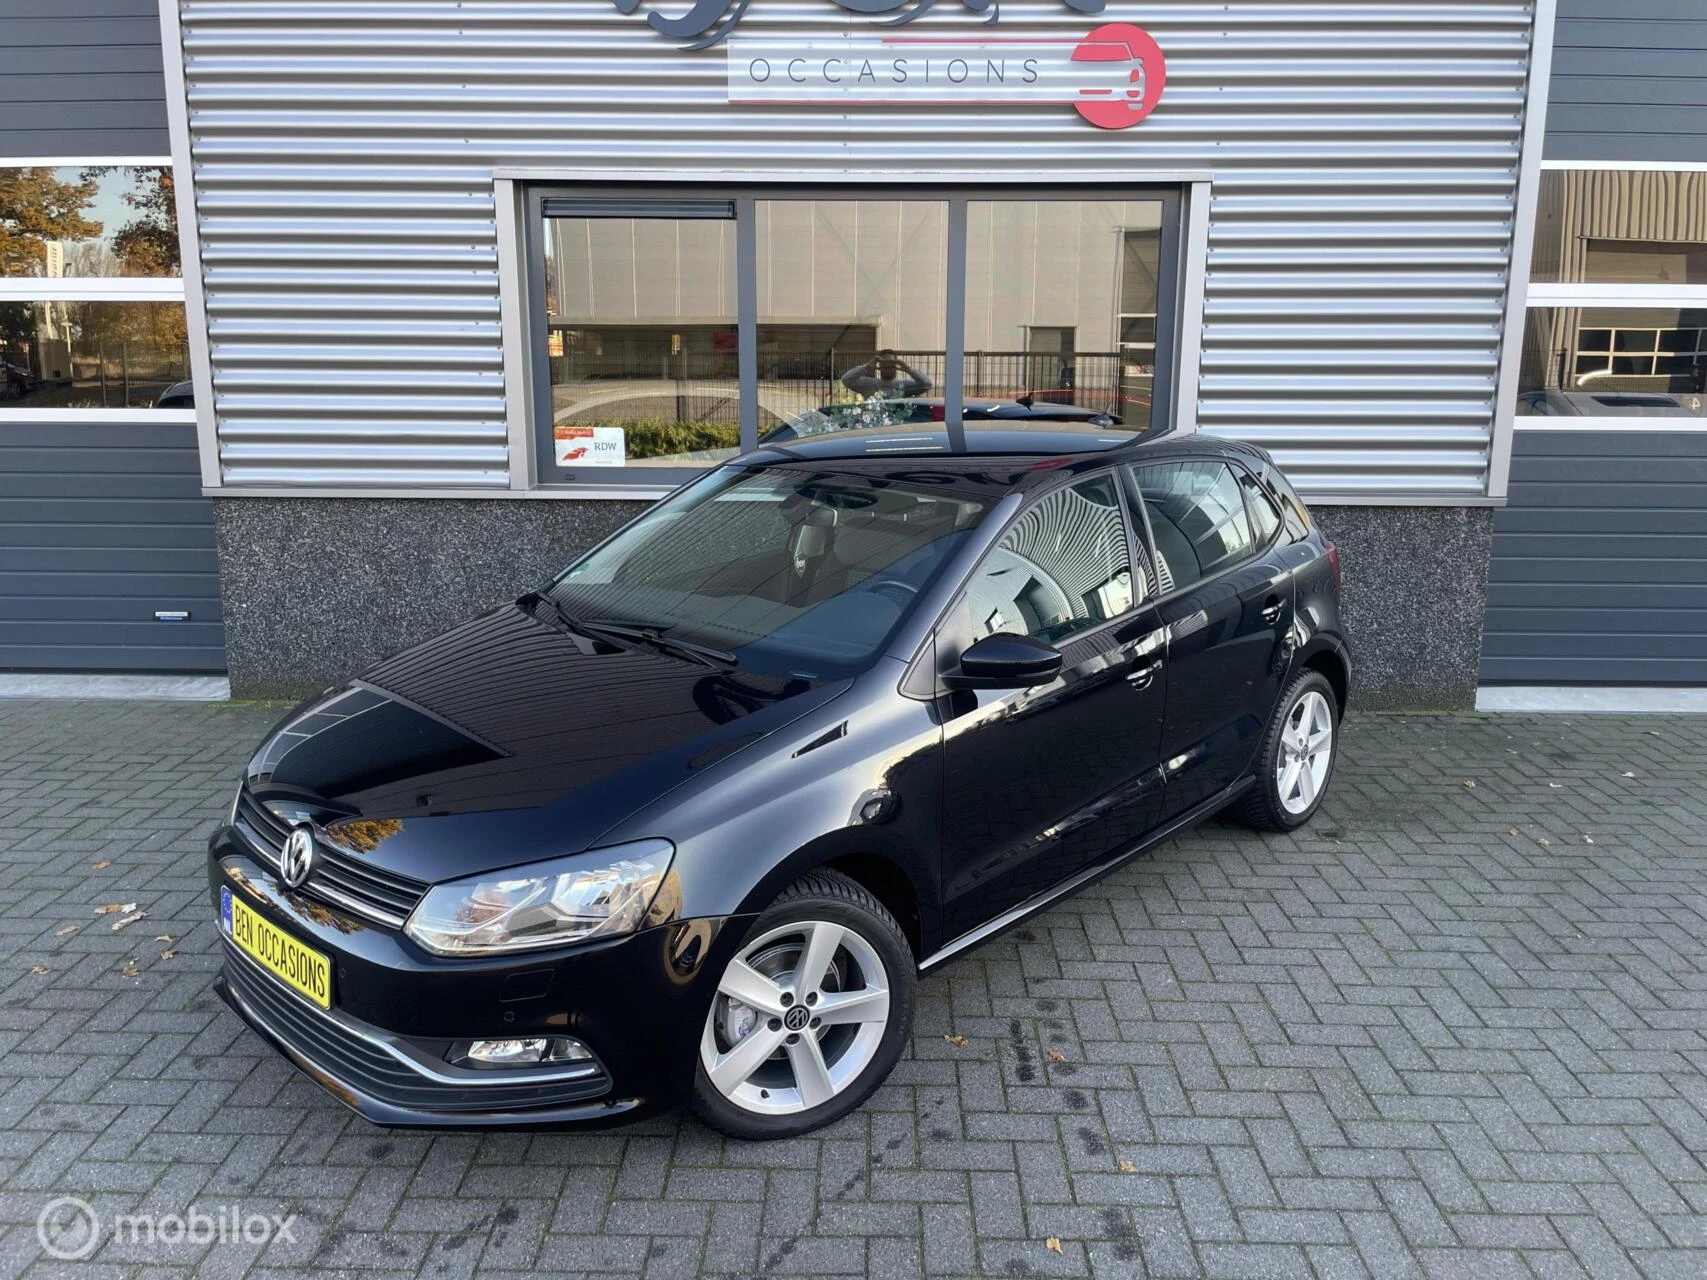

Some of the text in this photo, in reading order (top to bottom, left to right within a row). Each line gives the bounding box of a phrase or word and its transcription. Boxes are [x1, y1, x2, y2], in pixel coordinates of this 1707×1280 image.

[749, 58, 1039, 84] OCCASIONS
[594, 442, 616, 451] RDW
[235, 905, 325, 998] BEN OCCASIONS
